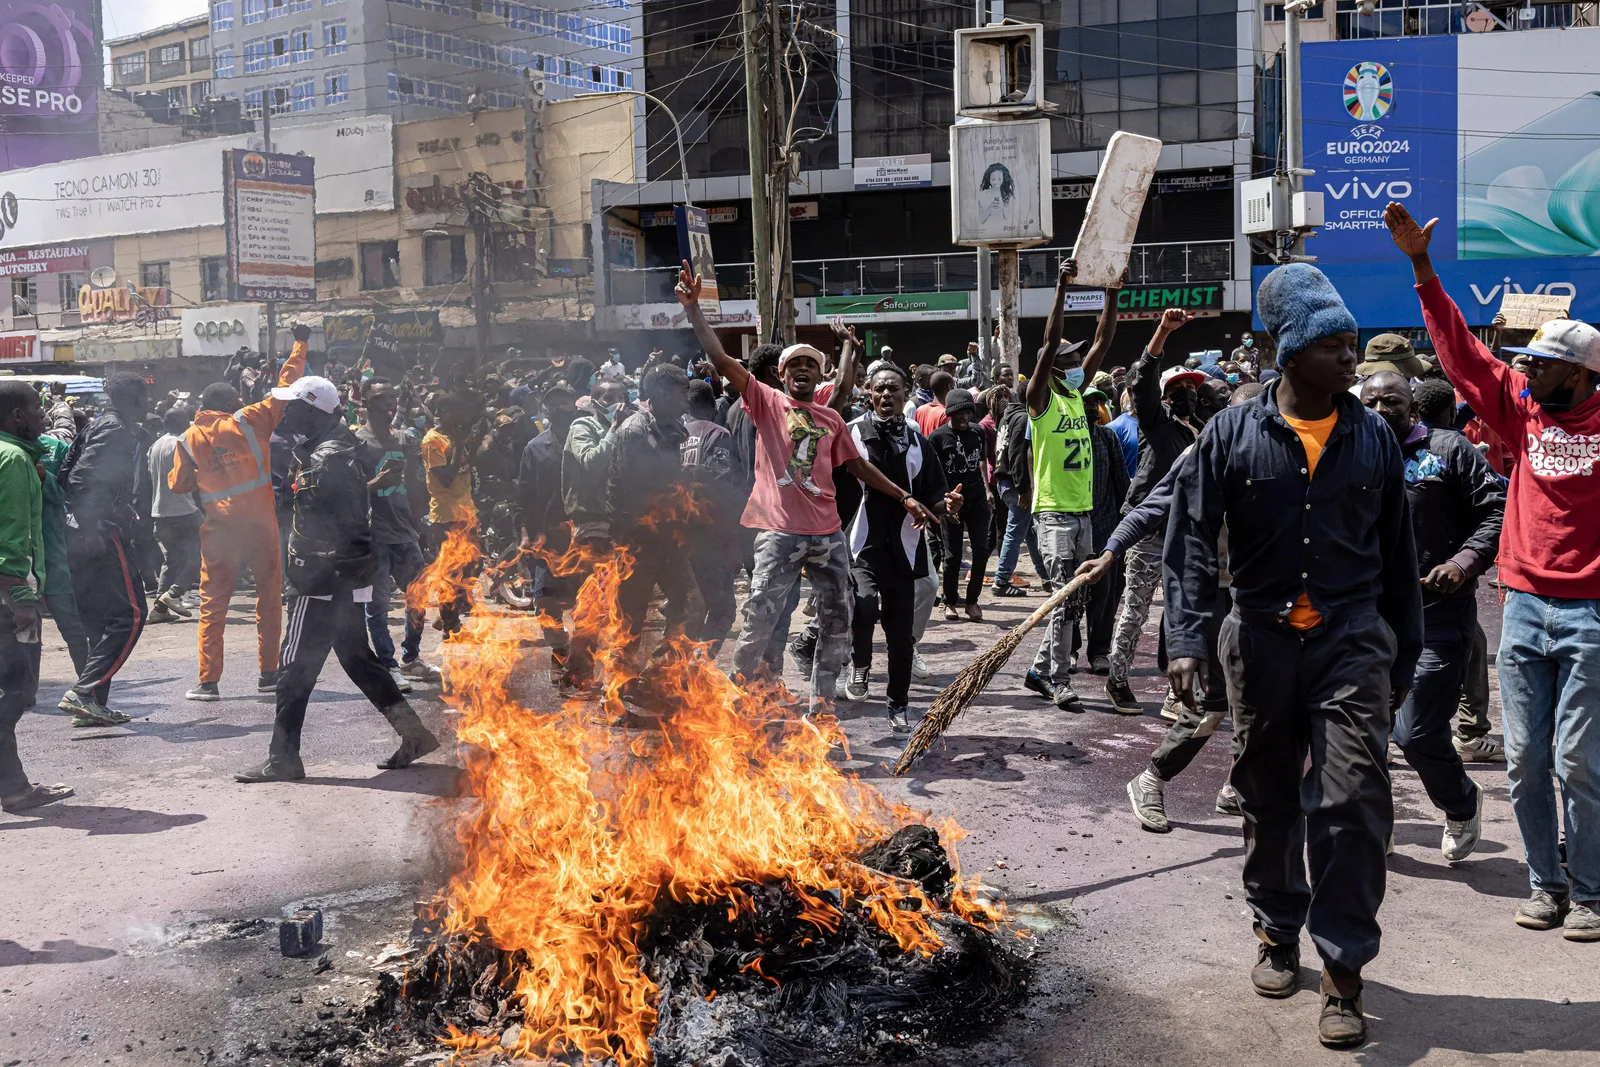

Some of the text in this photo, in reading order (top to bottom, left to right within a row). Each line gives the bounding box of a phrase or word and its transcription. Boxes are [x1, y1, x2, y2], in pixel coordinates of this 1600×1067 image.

[0, 86, 82, 113] SE PRO
[346, 127, 364, 136] Dolby
[1352, 127, 1381, 138] UEFA
[1345, 156, 1390, 164] GERMANY
[55, 178, 88, 198] TECNO
[92, 171, 137, 192] CAMON
[143, 168, 157, 186] 30
[1325, 176, 1412, 200] vivo
[56, 207, 71, 219] TWS
[73, 206, 87, 217] True
[107, 199, 137, 213] WATCH
[140, 198, 154, 210] Pro
[156, 196, 162, 208] 2
[1340, 210, 1387, 219] OFFICIA
[1325, 221, 1389, 230] SMARTPH
[28, 246, 89, 260] RESTAURANT
[0, 262, 48, 276] BUTCHERY
[1117, 287, 1218, 308] CHEMIST
[1469, 276, 1577, 305] vivo
[193, 319, 244, 342] oppo
